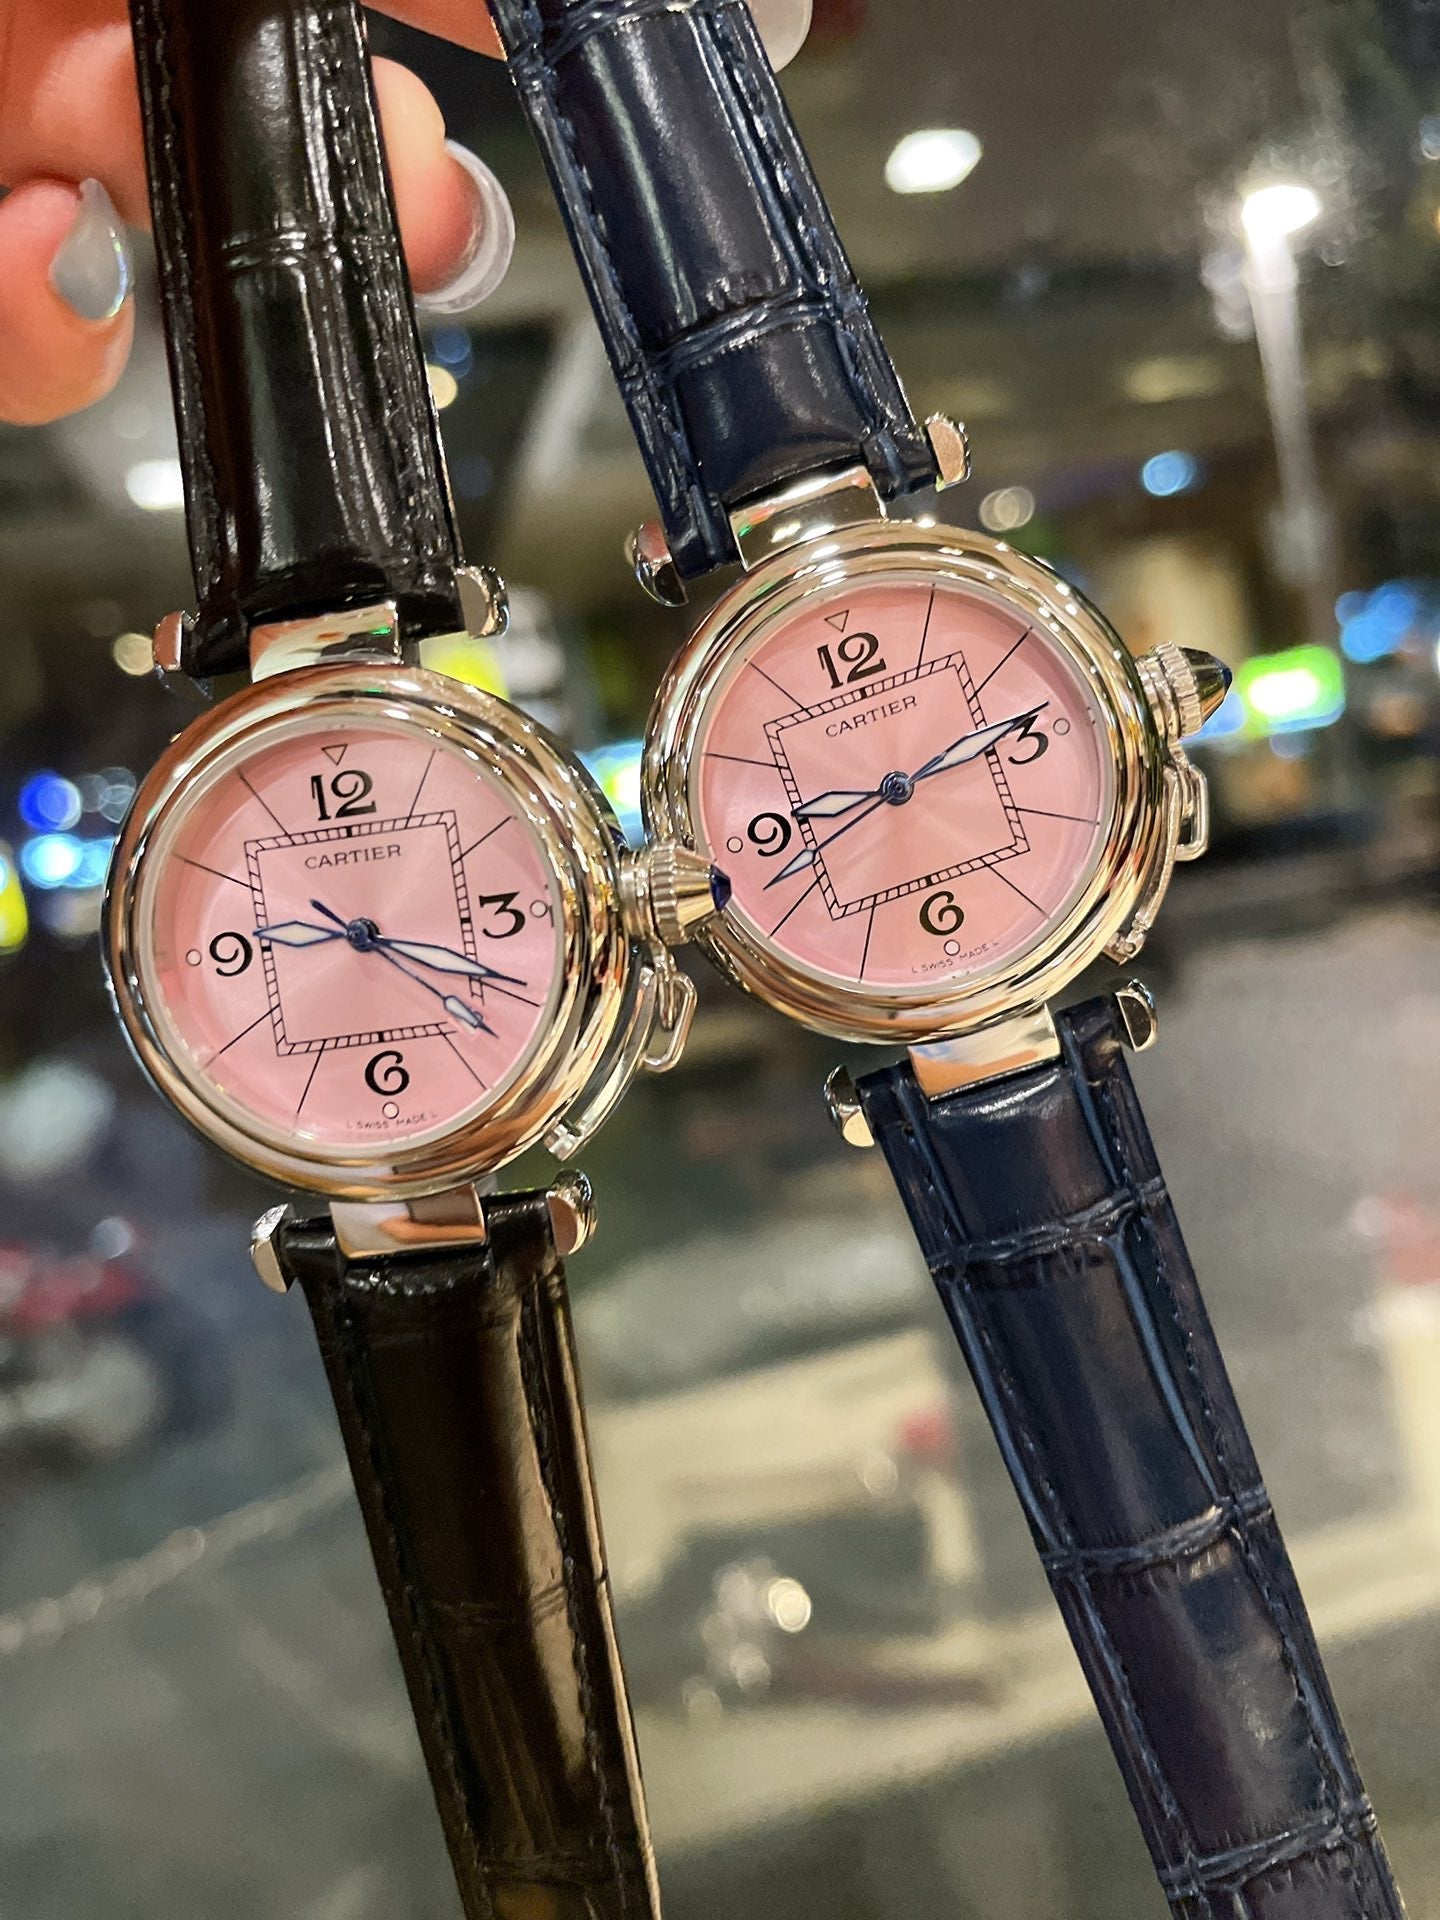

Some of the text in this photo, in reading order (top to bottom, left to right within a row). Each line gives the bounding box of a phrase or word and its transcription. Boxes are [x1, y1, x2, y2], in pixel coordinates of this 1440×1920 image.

[816, 631, 887, 690] 12
[825, 695, 918, 738] CARTIER
[1003, 713, 1049, 766] 3
[310, 769, 377, 821] 12
[304, 843, 402, 870] CARTIER
[747, 812, 792, 857] 9
[478, 890, 526, 939] 3
[919, 890, 965, 936] 6
[209, 931, 253, 977] 9
[921, 957, 954, 972] SWISS
[959, 943, 990, 961] MADE
[364, 1050, 410, 1097] 6
[356, 1120, 390, 1130] SWISS
[396, 1112, 428, 1128] MADE
